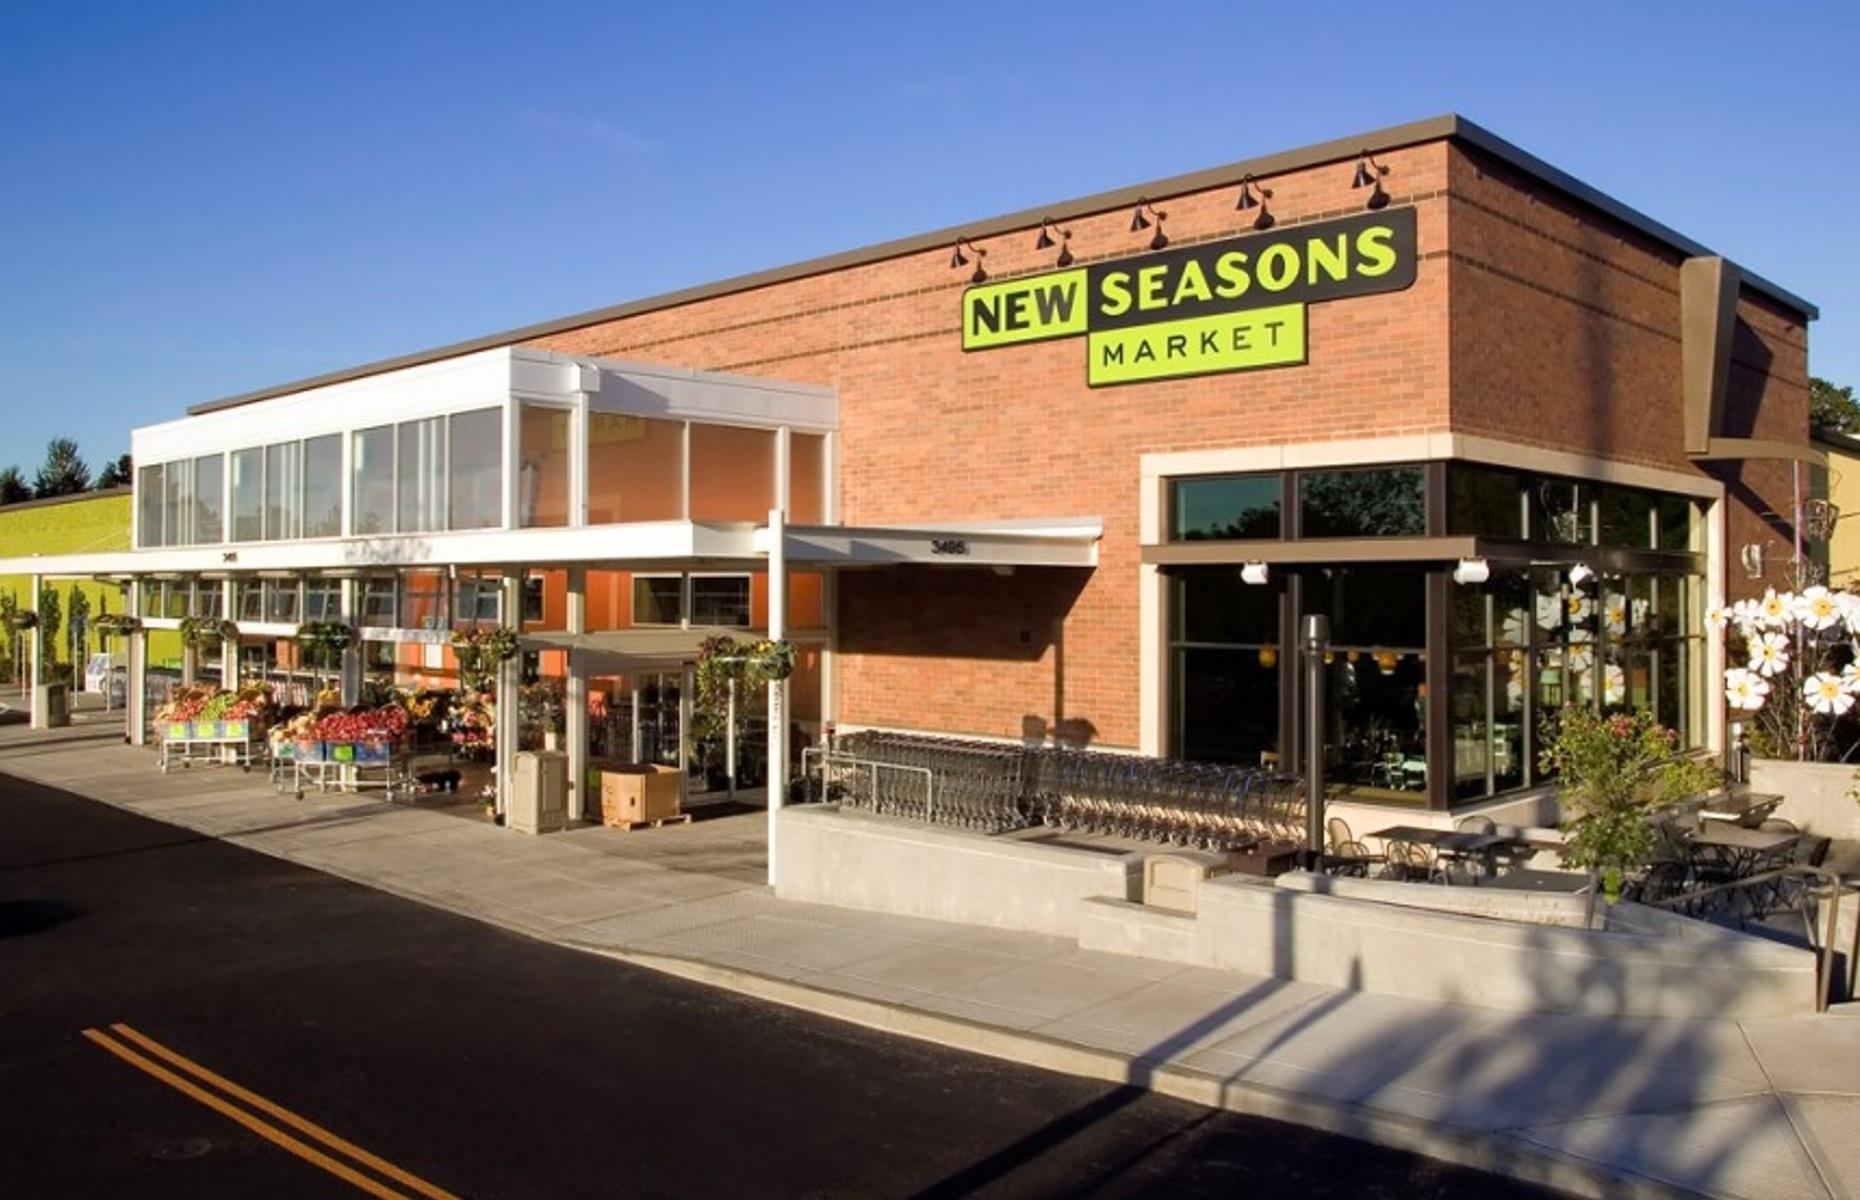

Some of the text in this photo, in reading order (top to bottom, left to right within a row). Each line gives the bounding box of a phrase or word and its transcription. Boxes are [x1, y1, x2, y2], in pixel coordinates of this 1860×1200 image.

[972, 226, 1398, 336] NEW SEASONS
[1103, 321, 1286, 367] MARKET
